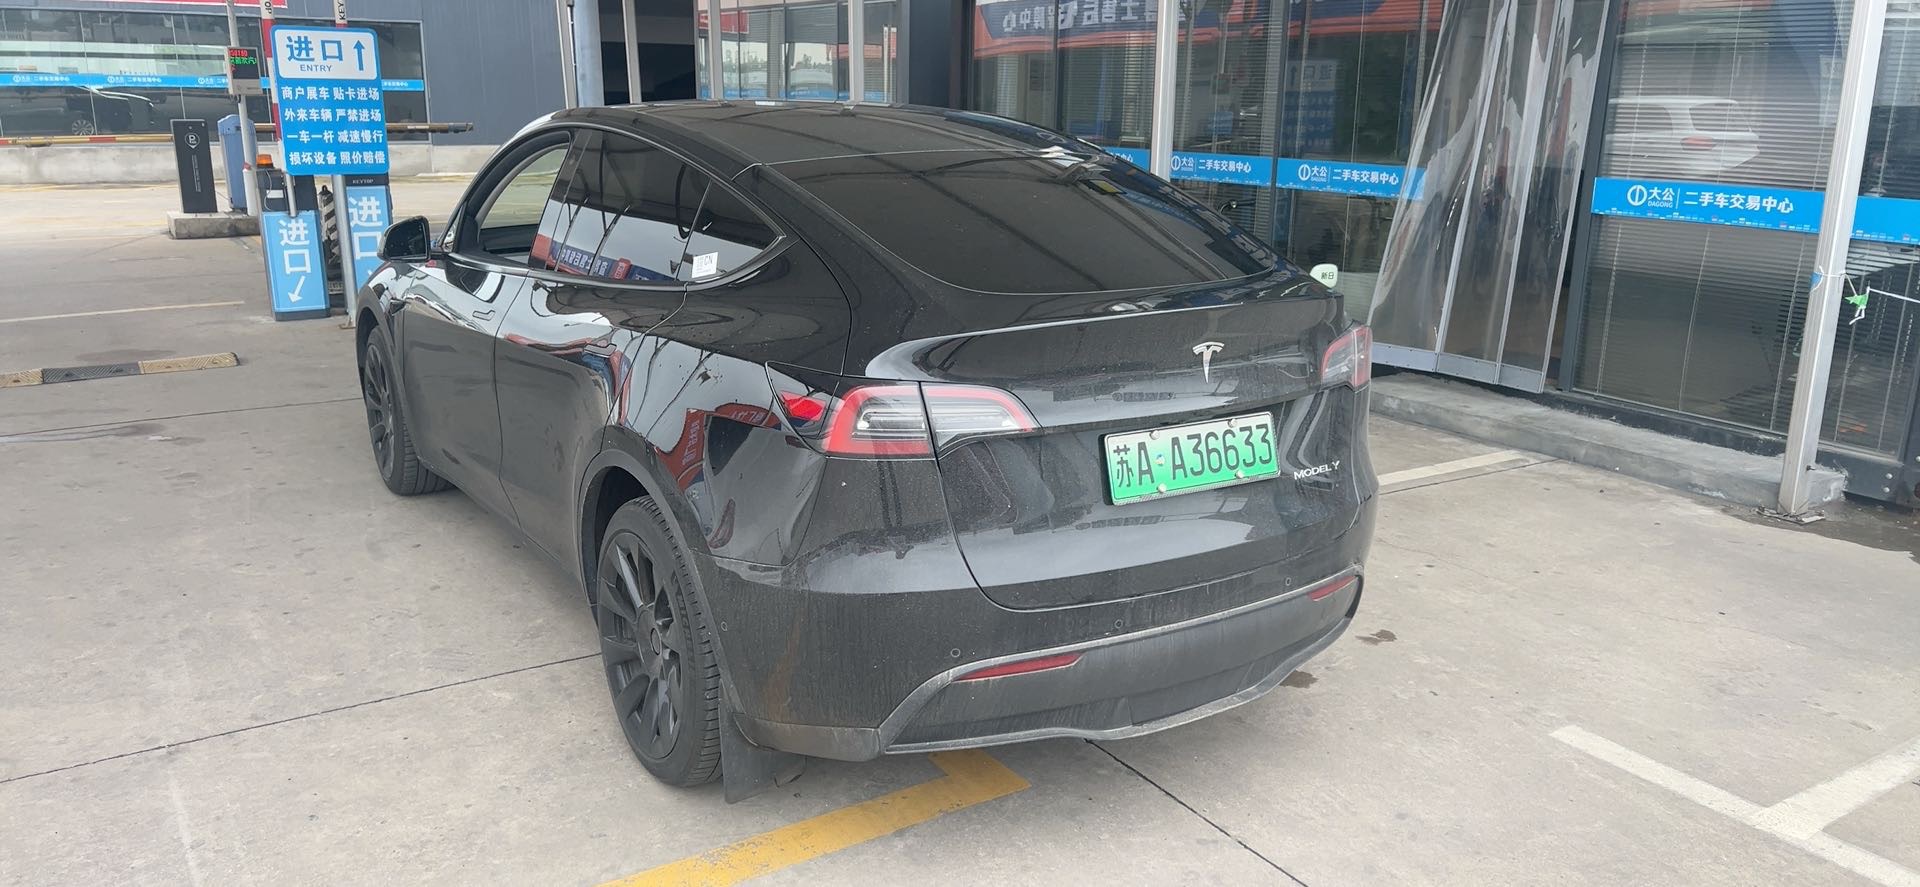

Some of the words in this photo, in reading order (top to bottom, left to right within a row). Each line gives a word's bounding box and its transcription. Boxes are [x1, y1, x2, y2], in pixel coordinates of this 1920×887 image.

[286, 35, 343, 62] 进口
[300, 64, 332, 72] ENTRY
[281, 86, 330, 100] 商户展车
[333, 87, 380, 101] 贴卡进场
[284, 108, 333, 122] 外来车辆
[336, 108, 382, 122] 严禁进场
[287, 129, 335, 143] 一车一杆
[337, 130, 383, 143] 减速慢行
[289, 151, 337, 165] 损坏设备
[340, 151, 385, 164] 照价赔偿
[1198, 159, 1251, 173] 二手车交易中心
[1311, 166, 1328, 177] 大公
[1333, 169, 1400, 185] 二手车交易中心
[1647, 186, 1675, 202] 大公
[1683, 191, 1794, 214] 二手车交易中心
[1647, 200, 1673, 209] DAGONG
[347, 196, 383, 260] 进口
[278, 218, 312, 275] 进口
[1320, 271, 1335, 280] 新日
[1294, 464, 1332, 480] MODEL
